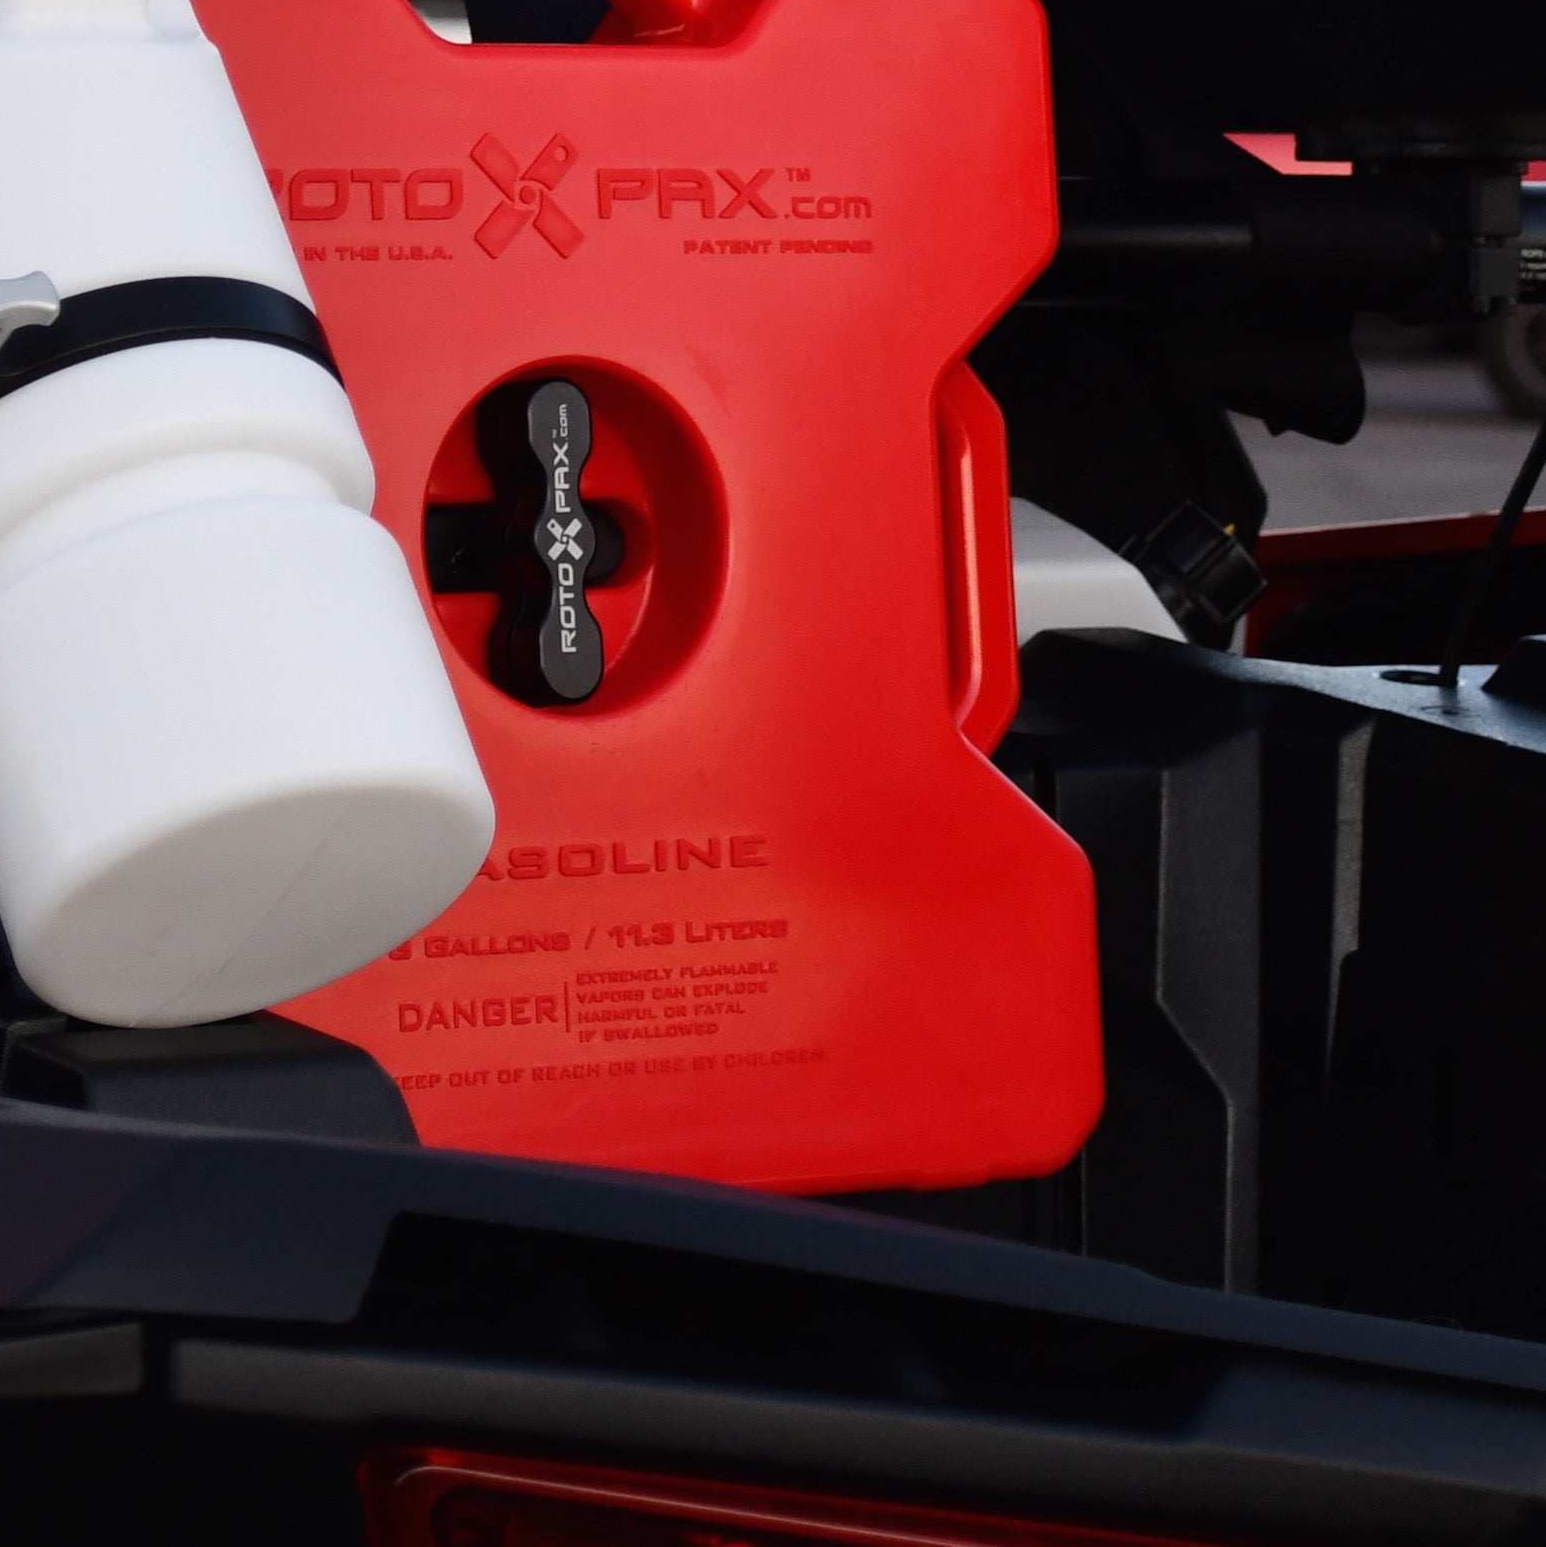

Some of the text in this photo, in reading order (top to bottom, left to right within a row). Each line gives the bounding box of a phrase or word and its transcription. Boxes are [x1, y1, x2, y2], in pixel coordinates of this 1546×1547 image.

[304, 245, 454, 261] IN THE U.S.A.
[683, 239, 873, 255] PATENT PENDING
[557, 562, 577, 654] ROTO
[424, 931, 572, 959] GALLONS
[585, 925, 598, 950] /
[607, 921, 675, 949] 11.3
[685, 917, 790, 945] LITERS
[576, 961, 779, 986] EXTREMELY FLAMMABLE
[576, 980, 769, 1005] VAPORS CAN EXPLODE
[398, 995, 559, 1034] DANGER
[577, 1001, 746, 1025] HARMFUL OR FATAL
[578, 1022, 720, 1043] IF SWALLOWED
[448, 1069, 491, 1089] OUT
[497, 1067, 525, 1085] OF
[531, 1063, 601, 1082] REACH
[608, 1059, 637, 1077] OR
[645, 1056, 684, 1075] USE
[690, 1054, 718, 1073] BY
[723, 1047, 829, 1070] CHILDREN
